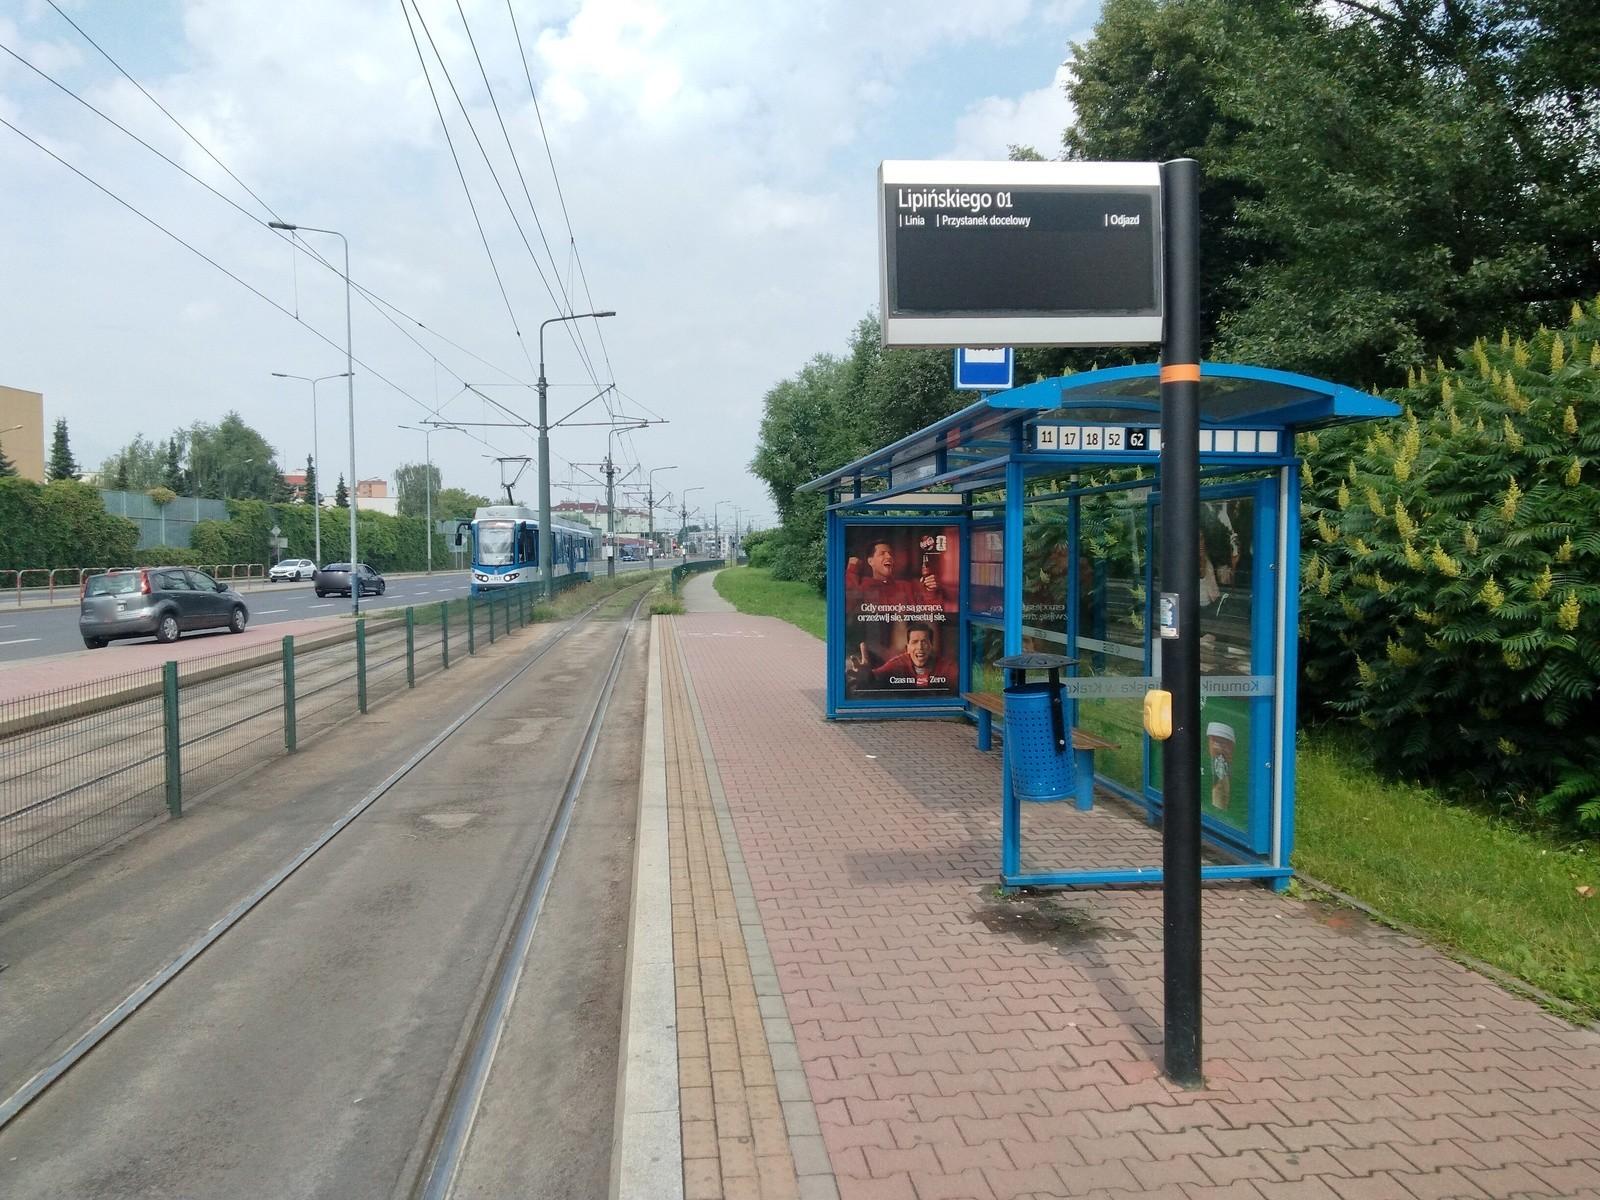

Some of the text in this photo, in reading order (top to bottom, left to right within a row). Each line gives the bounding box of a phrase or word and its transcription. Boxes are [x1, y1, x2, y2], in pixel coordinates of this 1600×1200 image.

[898, 188, 1013, 212] Lipińskiego 01
[905, 214, 1140, 228] Linia Przystanek docelowy Odjazd
[1041, 430, 1144, 446] 11 17 18 52 62
[861, 603, 943, 613] Gdy emocje są gorące,
[857, 613, 890, 623] orzeźwij
[903, 613, 933, 623] zresetuj
[934, 612, 946, 622] się.
[889, 676, 905, 684] Czas
[929, 675, 946, 684] Zero
